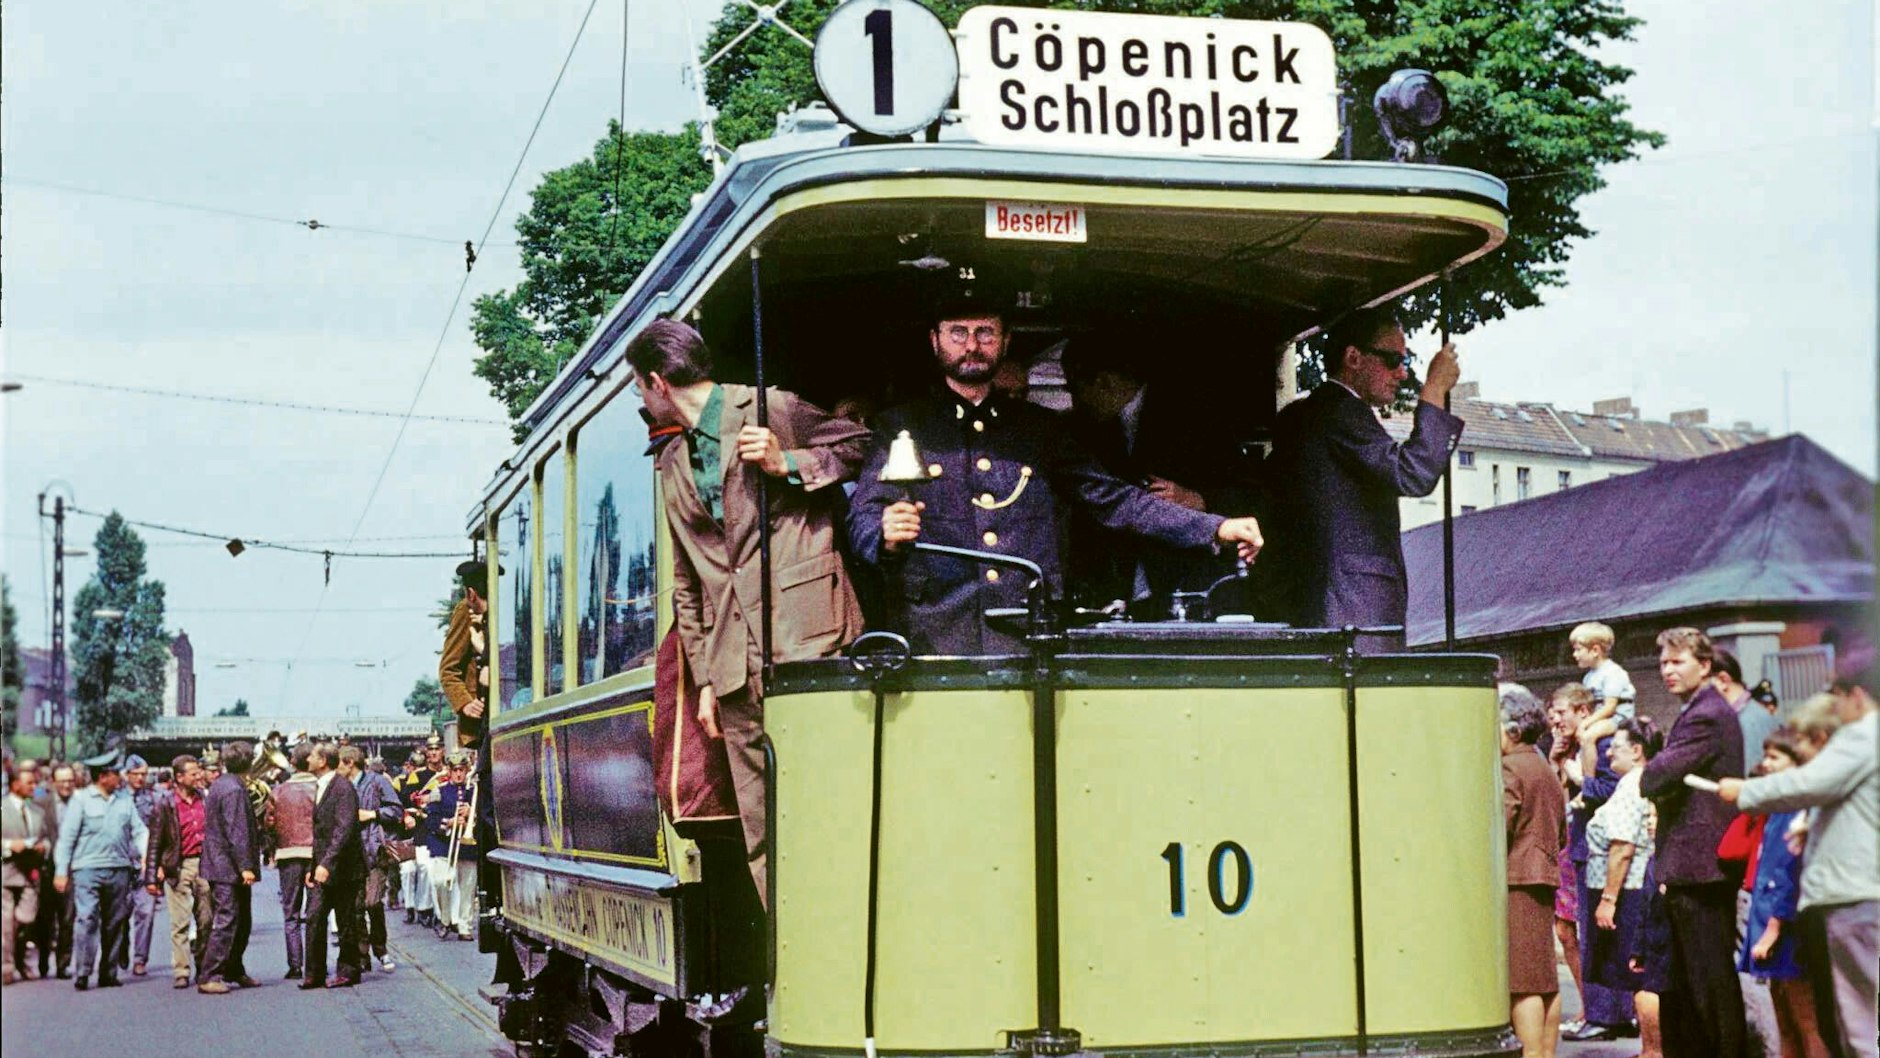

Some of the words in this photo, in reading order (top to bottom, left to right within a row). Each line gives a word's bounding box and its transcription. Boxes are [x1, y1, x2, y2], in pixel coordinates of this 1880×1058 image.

[865, 9, 894, 116] 1
[990, 17, 1301, 84] Cöpenick
[1000, 79, 1299, 147] Schloßplatz
[997, 206, 1078, 235] Besetzt!
[1160, 840, 1255, 918] 10
[653, 906, 667, 968] 10
